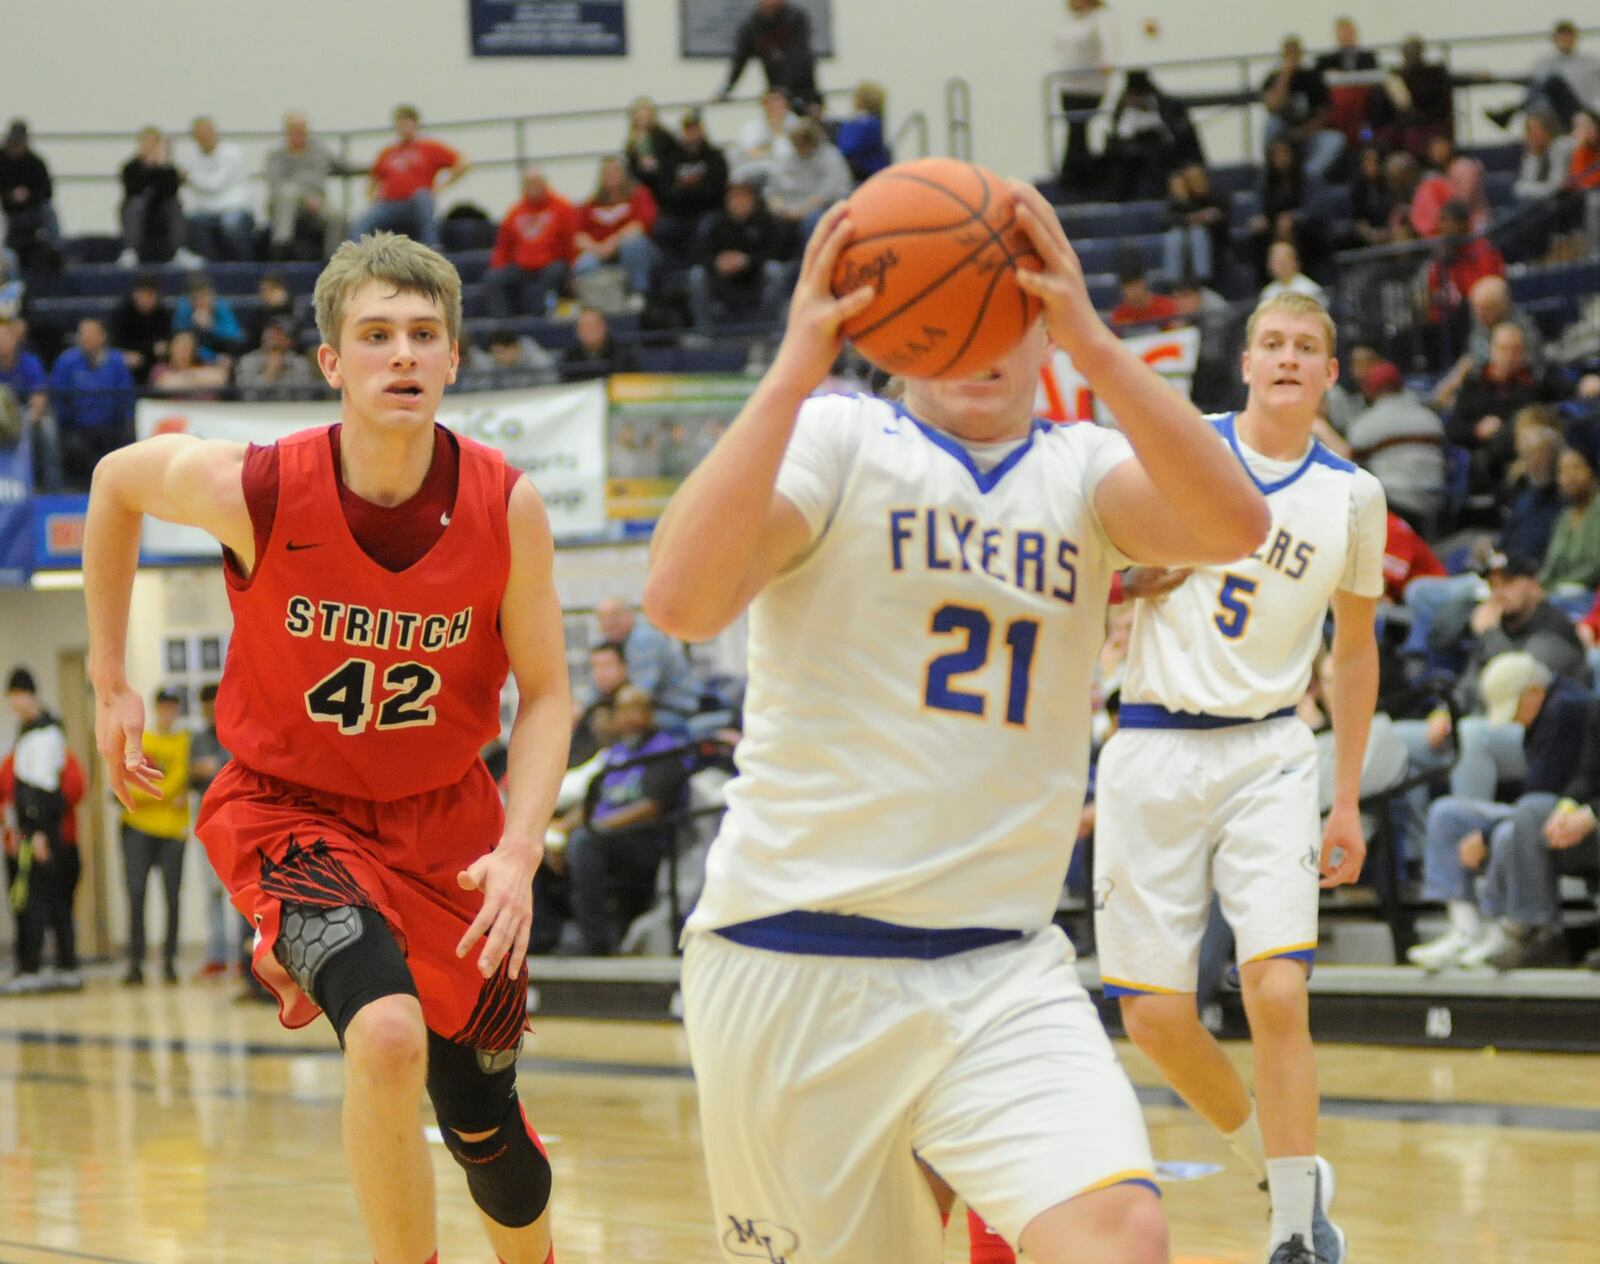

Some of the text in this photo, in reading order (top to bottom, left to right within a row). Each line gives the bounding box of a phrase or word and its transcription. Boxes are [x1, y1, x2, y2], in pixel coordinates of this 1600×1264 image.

[888, 507, 1080, 605] FLYERS
[285, 594, 473, 653] STRITCH
[1213, 571, 1260, 640] 5
[303, 657, 442, 736] 42
[922, 600, 1042, 730] 21
